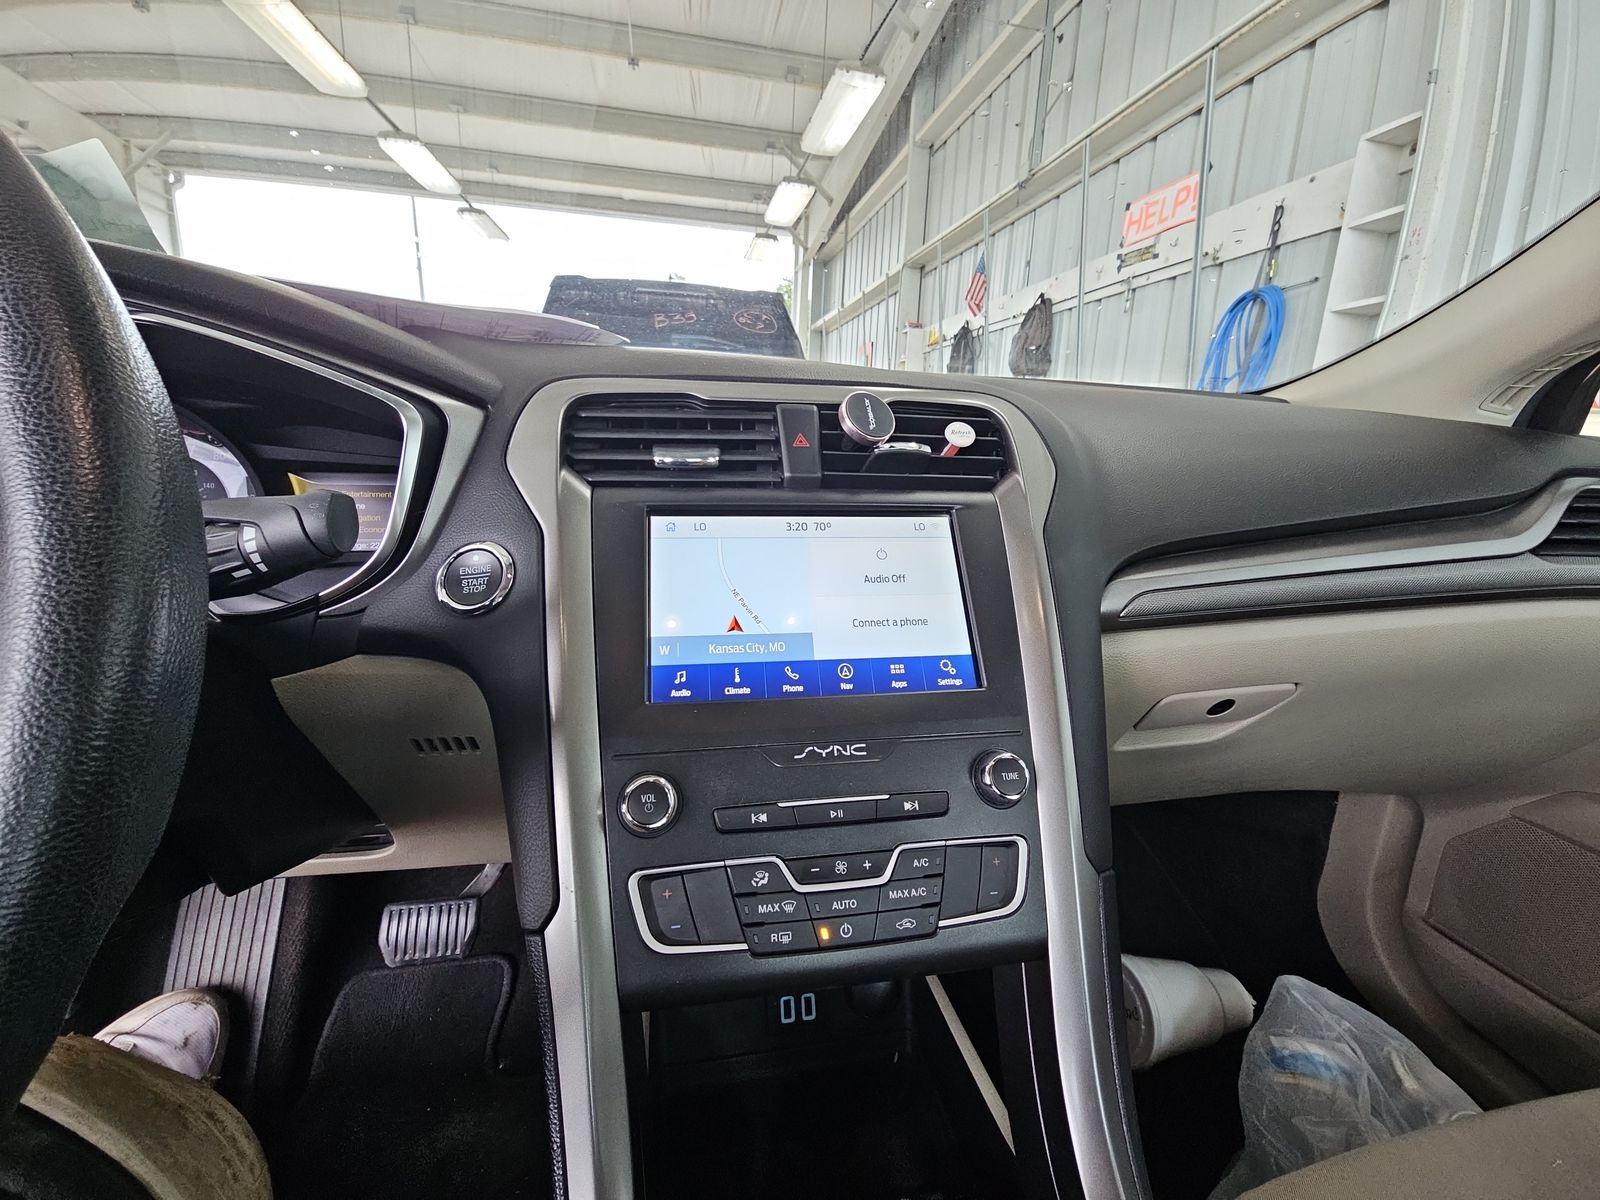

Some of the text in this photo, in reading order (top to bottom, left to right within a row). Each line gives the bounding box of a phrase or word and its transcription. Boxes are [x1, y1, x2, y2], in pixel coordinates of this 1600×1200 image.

[1124, 181, 1199, 239] HELP!
[693, 522, 707, 532] LO
[785, 522, 809, 532] 3:20
[913, 522, 926, 532] LO
[459, 564, 492, 575] ENGINE
[461, 577, 489, 587] START
[863, 573, 907, 584] Audio Off
[462, 585, 487, 594] STOP
[730, 588, 762, 625] NE Parvin Rd
[852, 616, 929, 628] Connect a phone
[658, 645, 671, 656] W
[708, 641, 786, 655] Kansas City, MO
[840, 682, 854, 691] Nav
[891, 680, 908, 689] Apps
[937, 677, 963, 686] Settings
[670, 688, 692, 698] Audio
[724, 686, 751, 696] Climate
[782, 684, 804, 693] Phone
[793, 743, 868, 759] SYNC
[1001, 771, 1020, 782] TUNE
[640, 793, 657, 804] VOL
[912, 858, 929, 868] A/C
[889, 887, 927, 899] MAX A/C
[757, 902, 781, 914] MAX
[831, 899, 858, 910] AUTO
[770, 931, 778, 943] R
